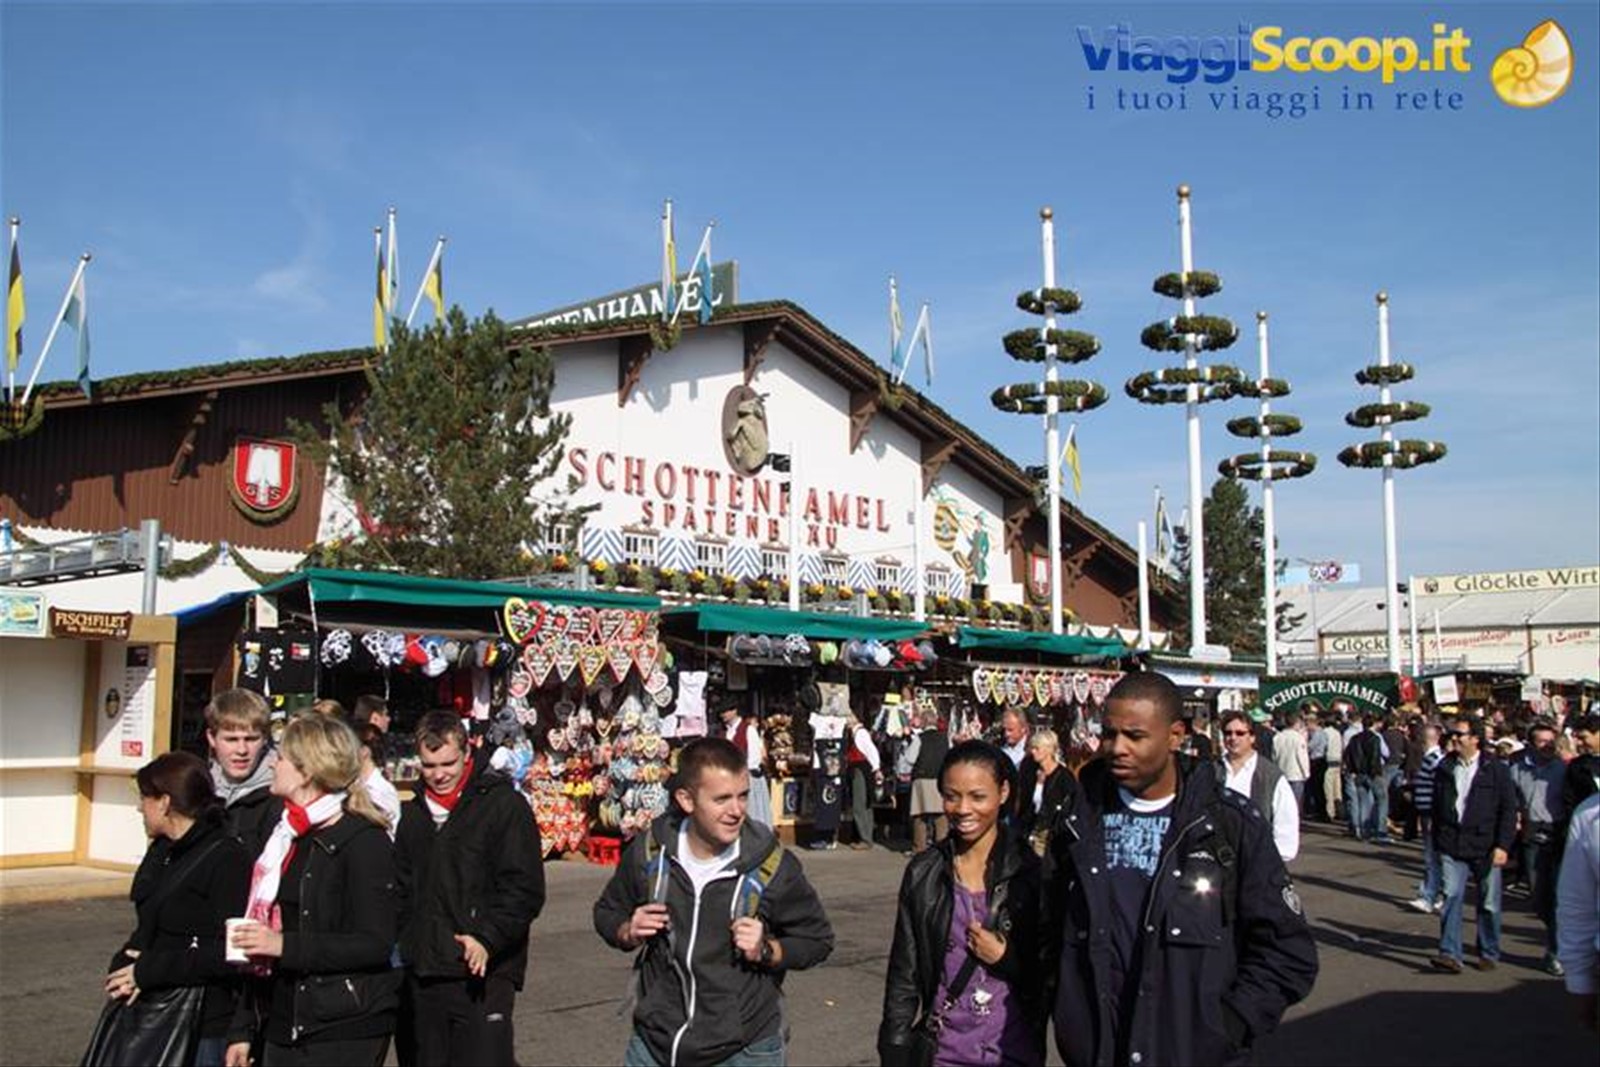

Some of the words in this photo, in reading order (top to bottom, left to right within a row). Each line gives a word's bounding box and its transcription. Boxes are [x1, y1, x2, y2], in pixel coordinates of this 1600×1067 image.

[1454, 574, 1540, 592] Glöckle
[55, 612, 126, 628] FISCHFILET
[1265, 680, 1388, 711] SCHOTTENHAMEL
